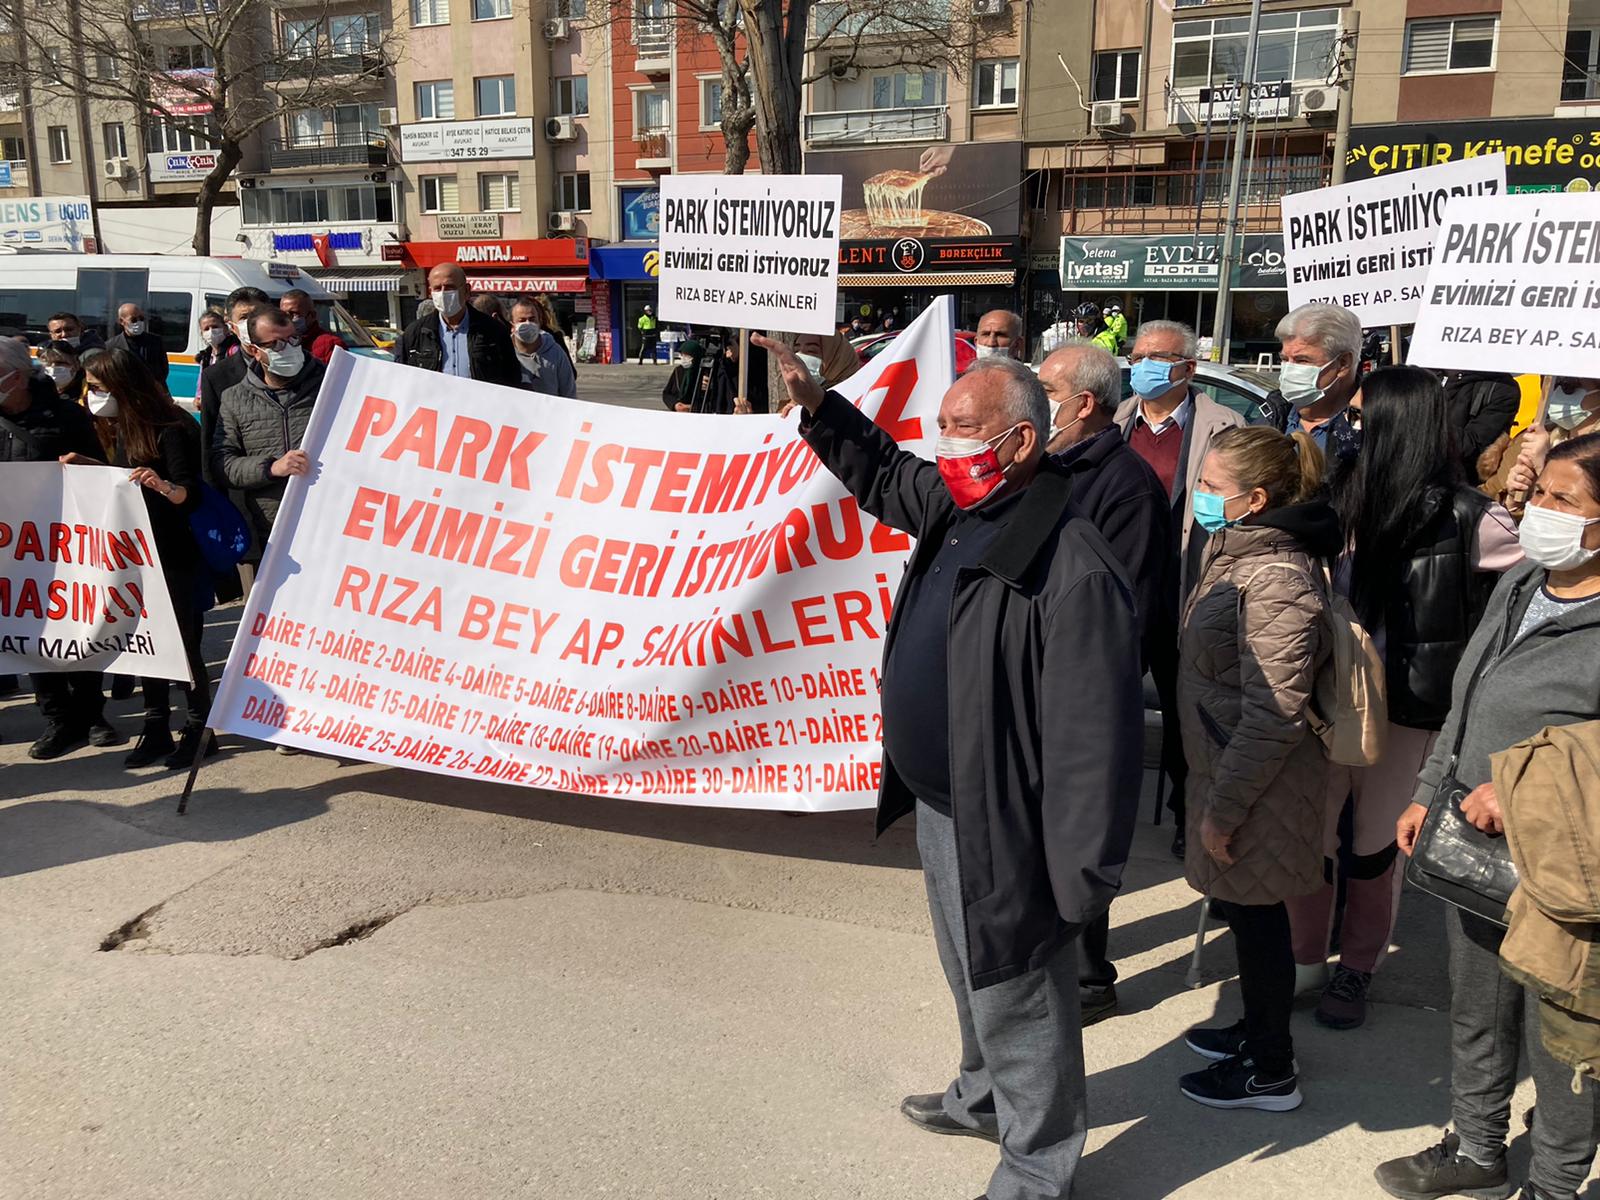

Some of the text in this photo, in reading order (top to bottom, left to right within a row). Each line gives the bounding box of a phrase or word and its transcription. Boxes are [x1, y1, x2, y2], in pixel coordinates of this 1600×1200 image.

[450, 146, 489, 157] 347 55 29
[1463, 137, 1575, 166] Künefe
[440, 215, 465, 223] AVUKAT
[665, 187, 834, 239] PARK İSTEMİYORUZ
[1290, 179, 1499, 250] PARK İSTEMİYO
[456, 245, 512, 262] AVANTAJ
[838, 247, 888, 264] LENT
[1082, 241, 1117, 260] Selena
[1145, 241, 1220, 263] EVDİZ
[1248, 249, 1286, 266] ab
[1442, 221, 1522, 265] PARK
[664, 247, 830, 278] EVİMİZİ GERİ İSTİYORUZ
[1153, 266, 1209, 274] HOME
[1293, 241, 1436, 284] EVİMİZİ GERİ İSTİ
[525, 280, 558, 291] AVM
[675, 286, 818, 311] RIZA BEY AP. SAKİNLERİ
[1343, 292, 1370, 308] BEY
[1373, 288, 1397, 304] AP.
[1430, 278, 1516, 307] EVİMİZİ
[1521, 279, 1577, 309] GERİ
[1441, 326, 1600, 349] RIZA BEY AP. SA
[345, 357, 924, 514] PARK İSTEMİYOZ
[342, 486, 911, 598] EVİMİZİ GERİ İSTİYORUZ
[333, 564, 893, 669] RIZA BEY AP. SAKİNLERİ
[0, 631, 156, 661] AT MALİKLERİ
[251, 611, 306, 648] DAİRE
[307, 626, 375, 665] 1-DAİRE
[373, 644, 447, 683] 2-DAİRE
[444, 661, 519, 700] 4-DAİRE
[515, 677, 577, 714] 5-DAİRE
[574, 683, 624, 720] 6-DAİRE
[626, 686, 681, 722] 8-DAİRE
[681, 679, 768, 719] 9-DAİRE
[770, 663, 867, 703] 10-DAİRE
[243, 652, 298, 690] DAİRE
[300, 666, 316, 694] 14
[381, 687, 460, 730] 15-DAİRE
[460, 708, 531, 747] 17-DAİRE
[529, 724, 600, 759] 18-DAİRE
[597, 729, 682, 763] 19-DAİRE
[678, 721, 771, 758] 20-DAİRE
[774, 708, 868, 746] 21-DAİRE
[241, 694, 882, 795] DAİRE 24-DAİRE 25-DAİRE 26-DAİRE 27-DAİRE 29-DAİRE 30-DAİRE 31-DAİRE
